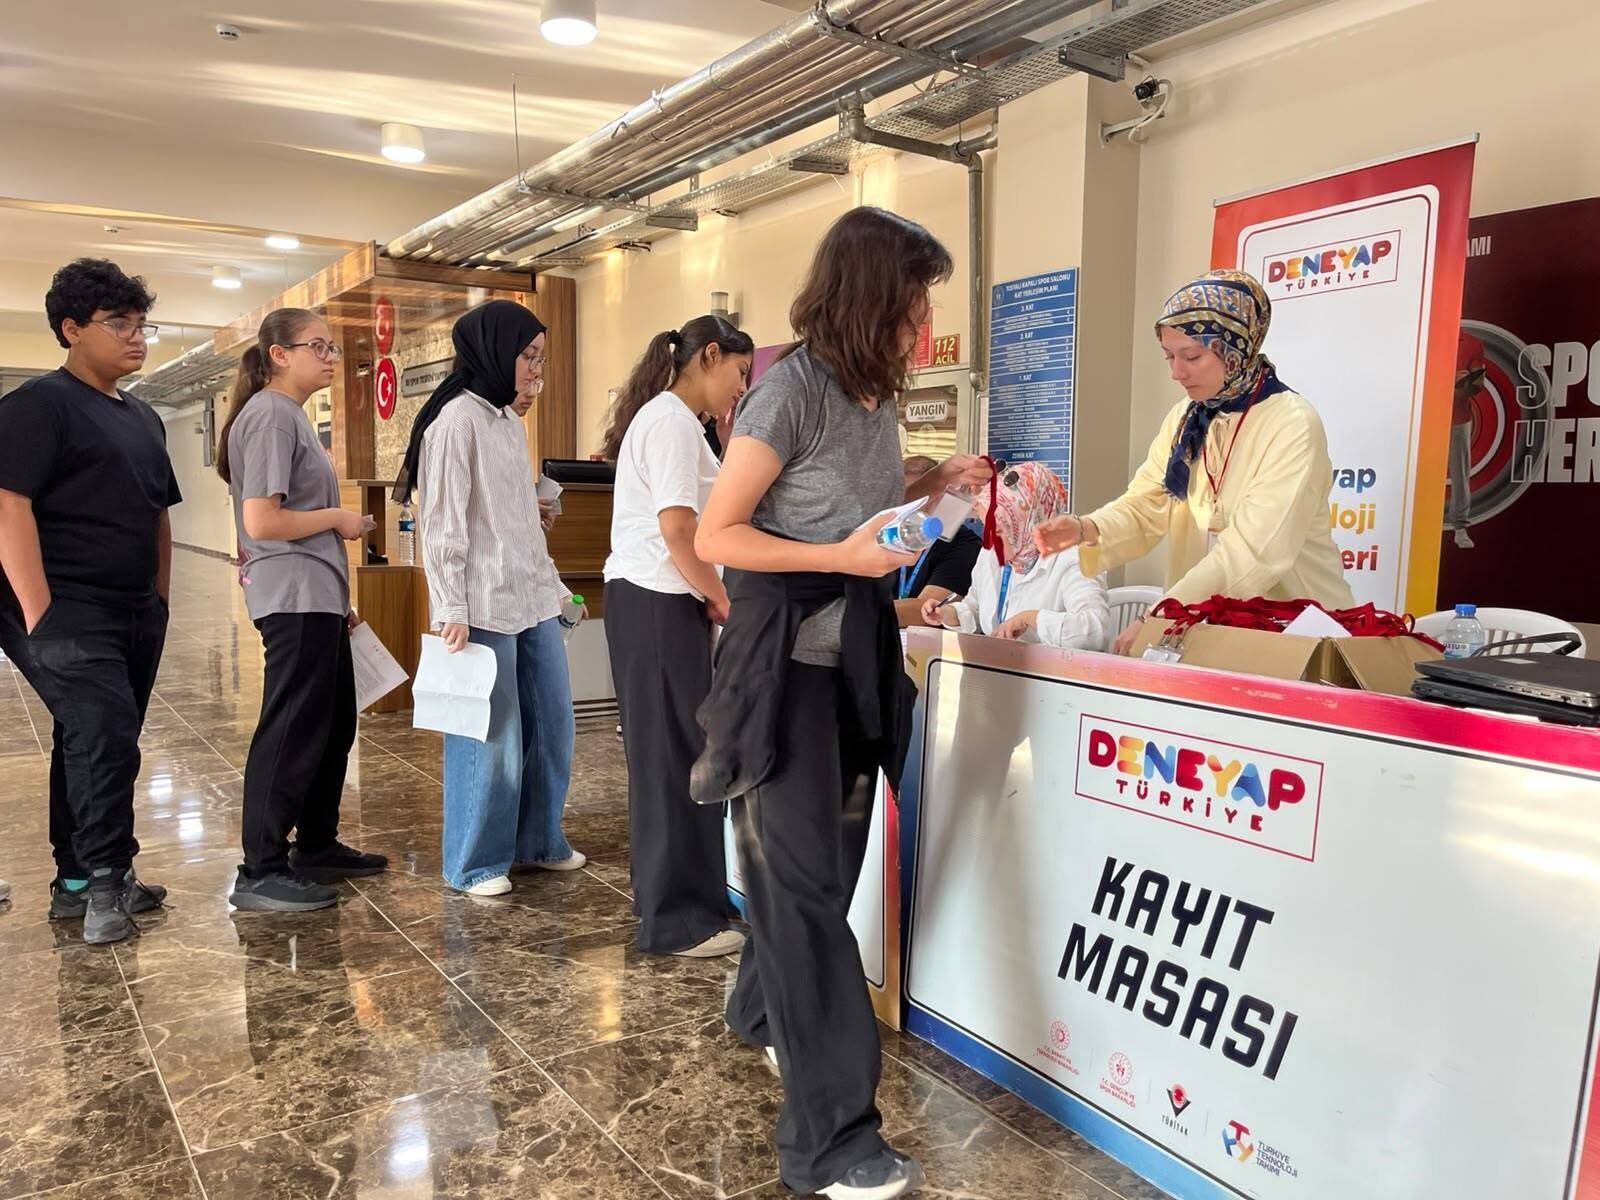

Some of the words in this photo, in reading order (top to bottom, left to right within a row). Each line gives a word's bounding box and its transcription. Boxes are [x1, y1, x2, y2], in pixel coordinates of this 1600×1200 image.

[1268, 240, 1392, 283] DENEYAP
[1285, 270, 1370, 292] TÜRKİYE
[935, 337, 955, 353] 112
[935, 354, 955, 365] ACİL
[909, 403, 945, 416] YANGIN
[1341, 545, 1378, 571] eri
[1088, 729, 1305, 811] DENEYAP
[1116, 779, 1263, 832] TÜRKİYE
[1091, 856, 1275, 971] KAYIT
[1057, 922, 1299, 1081] MASASI
[1161, 1114, 1188, 1136] TÜBİTAK
